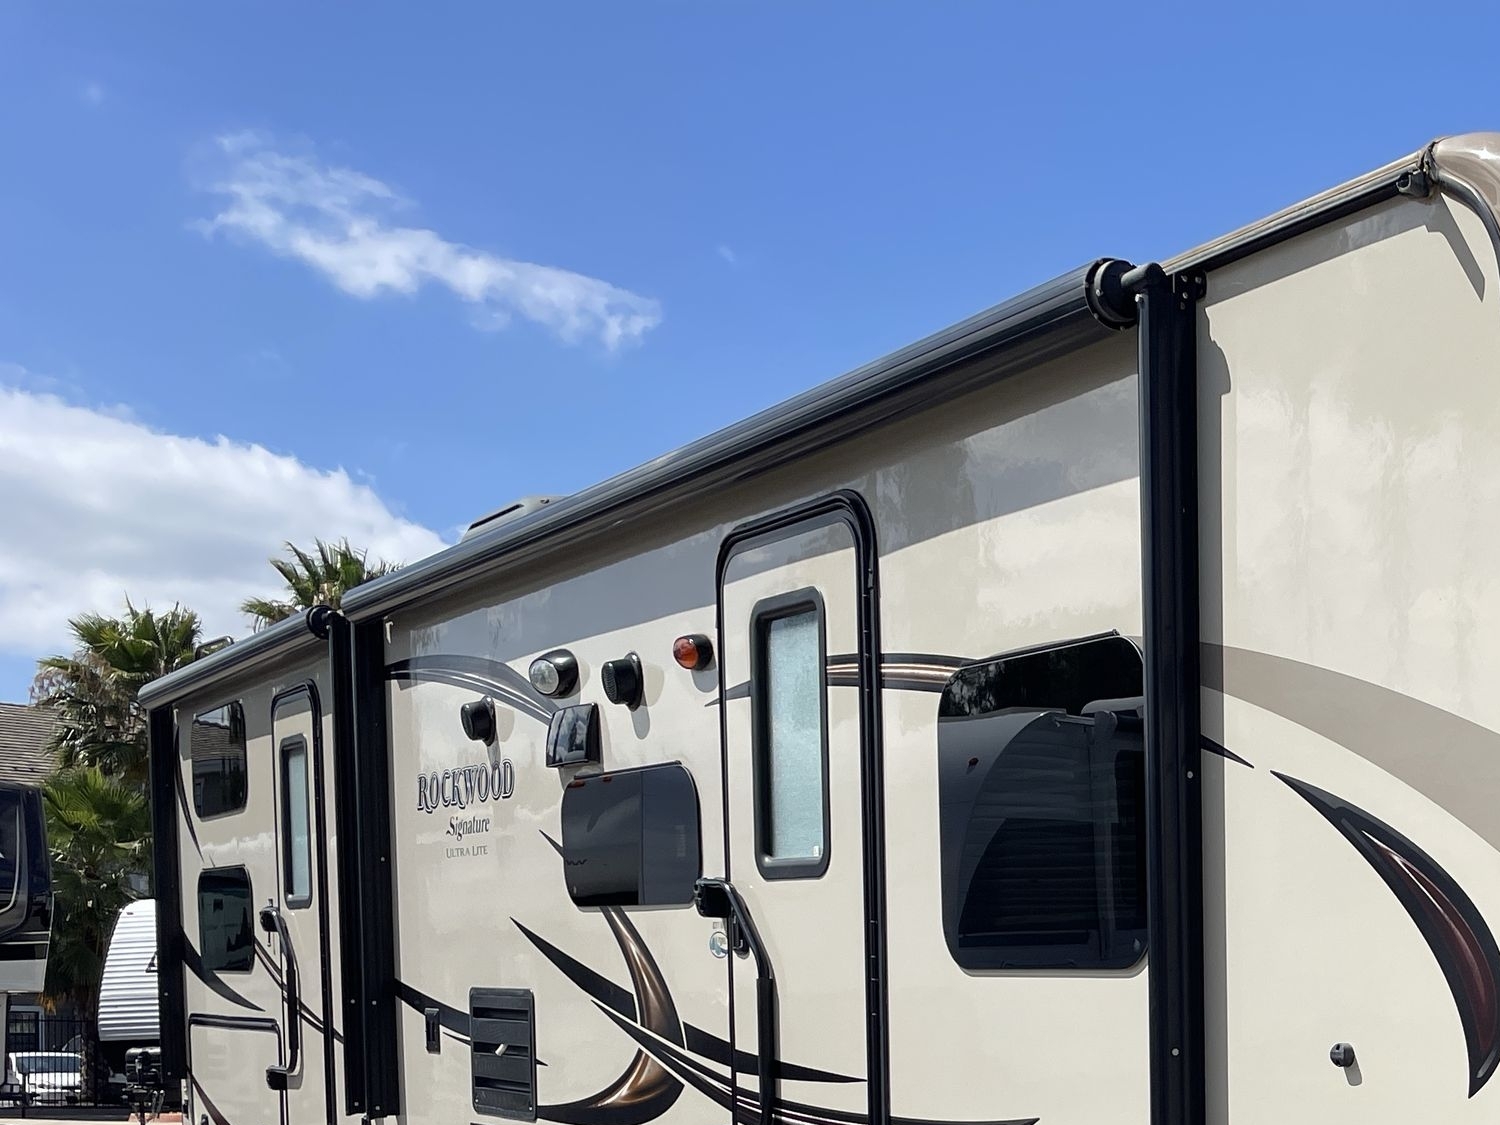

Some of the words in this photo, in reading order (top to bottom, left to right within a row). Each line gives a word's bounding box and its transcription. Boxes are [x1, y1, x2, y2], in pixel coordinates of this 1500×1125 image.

[417, 758, 515, 814] ROCKWOOD
[445, 816, 490, 841] Signature
[446, 847, 471, 858] ULTRA
[472, 845, 488, 856] LITE
